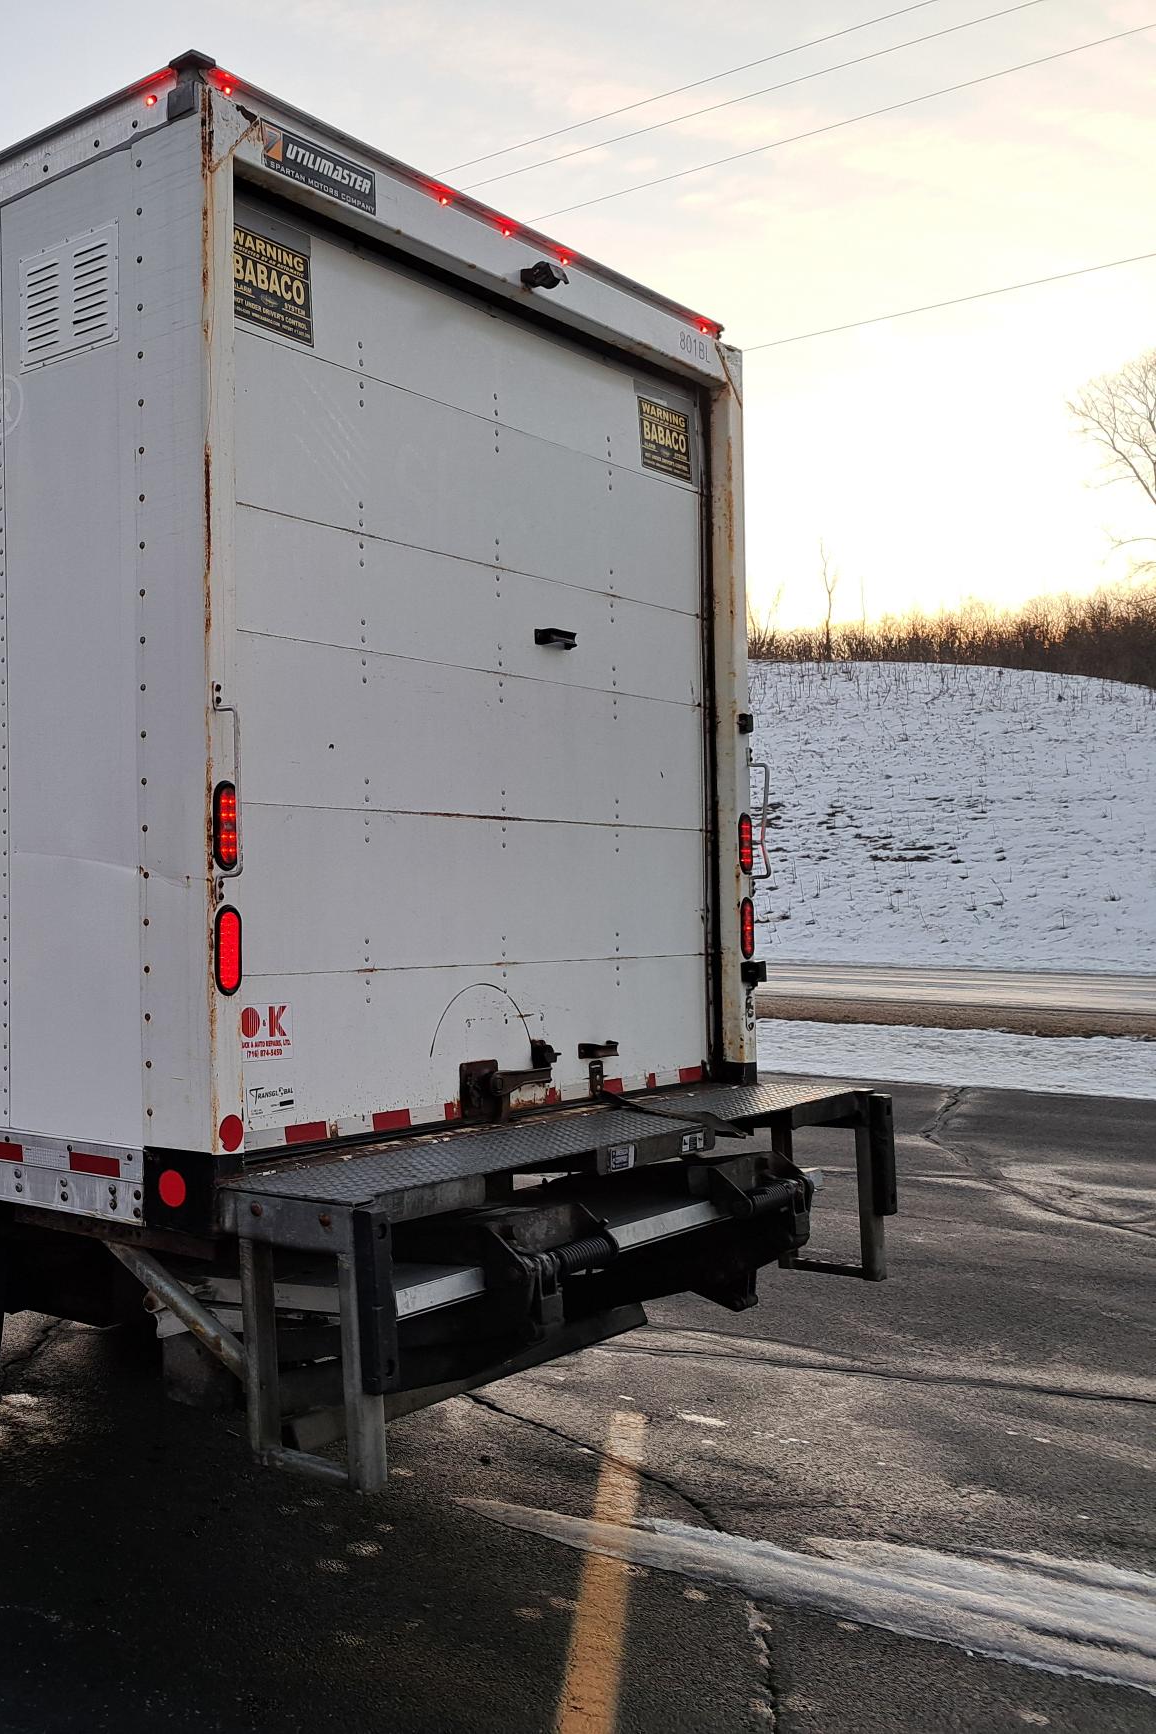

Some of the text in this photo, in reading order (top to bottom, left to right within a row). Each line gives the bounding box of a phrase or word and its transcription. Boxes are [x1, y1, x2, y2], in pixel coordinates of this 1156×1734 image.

[286, 143, 371, 194] UTILIMASTER
[270, 161, 306, 184] SPARTAN
[308, 179, 339, 198] MOTORS
[341, 193, 376, 213] COMPANY
[234, 244, 261, 259] ROTECTED
[233, 252, 305, 306] BABACO
[679, 331, 711, 363] 801BL
[641, 401, 686, 428] WARNING
[643, 420, 687, 454] BABACO
[268, 1005, 287, 1037] K
